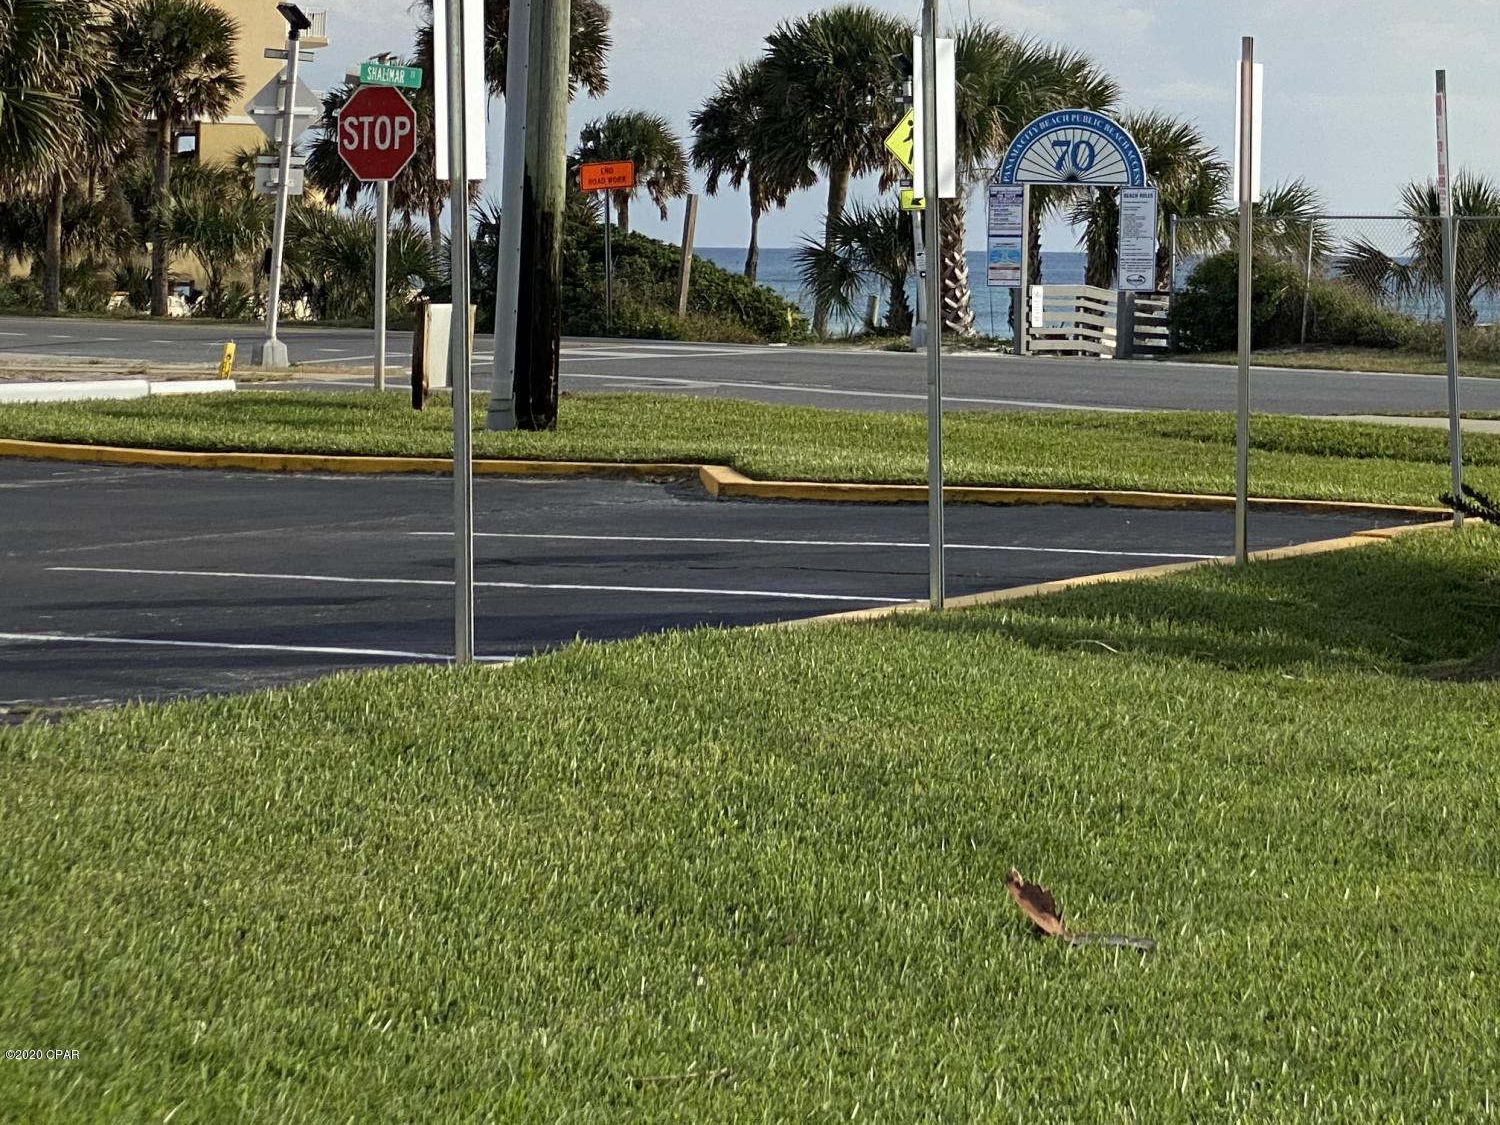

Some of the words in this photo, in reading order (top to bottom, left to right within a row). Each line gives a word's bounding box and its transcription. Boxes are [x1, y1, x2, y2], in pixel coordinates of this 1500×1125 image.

[366, 66, 405, 84] SHALIMAR
[342, 115, 411, 151] STOP
[1002, 143, 1023, 182] PANAMA
[1020, 126, 1039, 146] CITY
[1039, 114, 1070, 130] BEACH
[1071, 114, 1103, 127] PUBLIC
[1103, 124, 1130, 149] BEACH
[600, 167, 614, 175] END
[1051, 139, 1096, 173] 70
